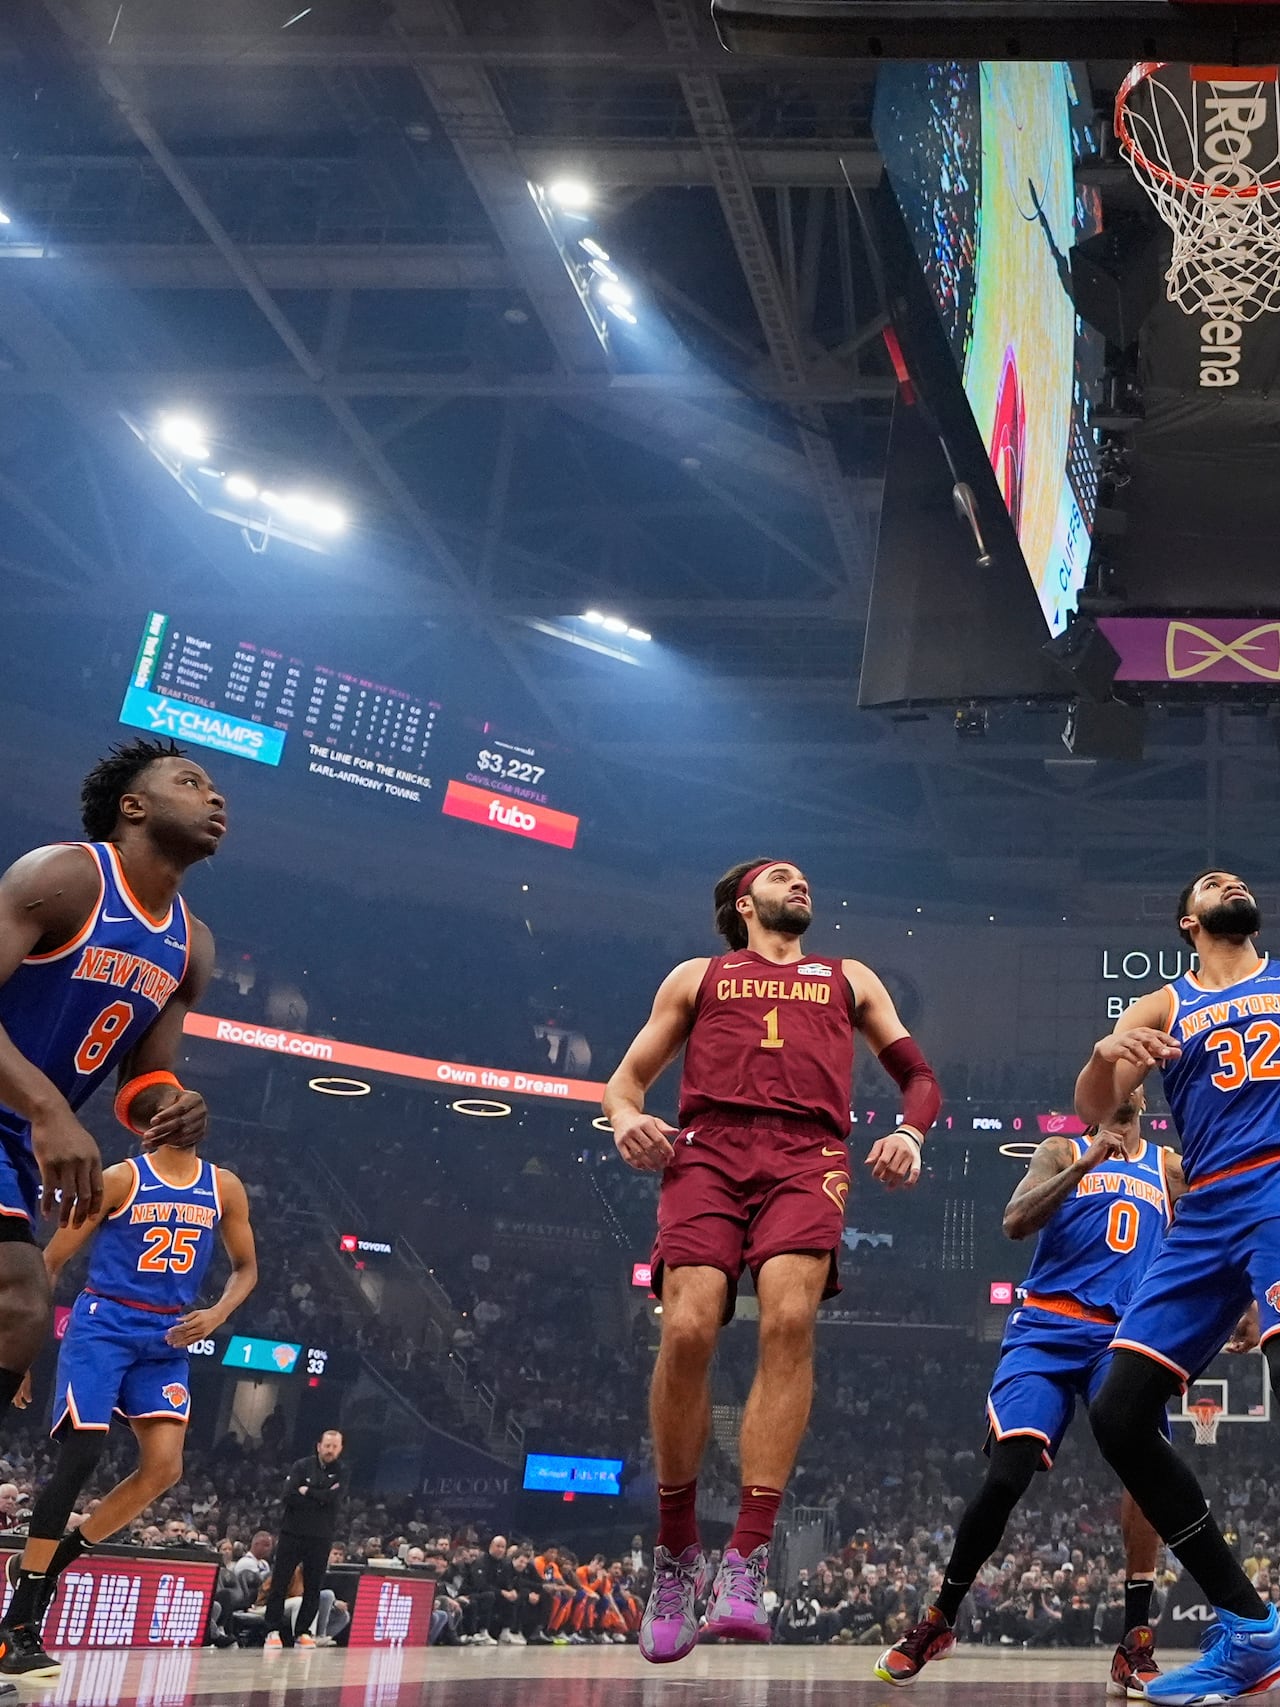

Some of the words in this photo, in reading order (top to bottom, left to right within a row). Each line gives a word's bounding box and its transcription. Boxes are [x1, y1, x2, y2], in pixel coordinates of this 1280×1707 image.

[1059, 503, 1080, 592] CLIFFS
[157, 685, 181, 698] TEAM
[182, 691, 216, 709] TOTALS
[180, 712, 264, 748] CHAMPS
[309, 744, 328, 759] THE
[330, 750, 352, 765] LINE
[354, 757, 375, 772] FOR
[376, 763, 395, 779] THE
[396, 768, 432, 788] KNICKS.
[310, 762, 384, 792] KARL-ANTHONY
[384, 784, 421, 802] TOWNS.
[477, 750, 545, 784] $3,227
[488, 800, 537, 831] fubo
[71, 946, 138, 988] NEW
[131, 961, 181, 1012] YORK
[716, 979, 830, 1004] CLEVELAND
[74, 1000, 134, 1075] 8
[216, 1020, 333, 1060] Rocket.com
[760, 1006, 784, 1048] 1
[1179, 1000, 1233, 1042] NEW
[437, 1064, 477, 1084] Own
[480, 1070, 510, 1088] the
[514, 1075, 568, 1096] Dream
[866, 1112, 876, 1124] 7
[946, 1116, 953, 1128] 1
[972, 1118, 1002, 1130] FG%
[1013, 1118, 1022, 1130] 0
[1150, 1120, 1168, 1131] 14
[1077, 1172, 1120, 1198] NEW
[1115, 1174, 1165, 1214] YORK
[130, 1204, 175, 1225] NEW
[173, 1202, 216, 1228] YORK
[1106, 1200, 1140, 1254] 0
[137, 1227, 202, 1274] 25
[357, 1240, 392, 1254] TOYOTA
[243, 1344, 252, 1364] 1
[307, 1360, 324, 1374] 33
[422, 1478, 509, 1496] LECOM
[56, 1572, 95, 1645] TO
[88, 1574, 142, 1645] NBA
